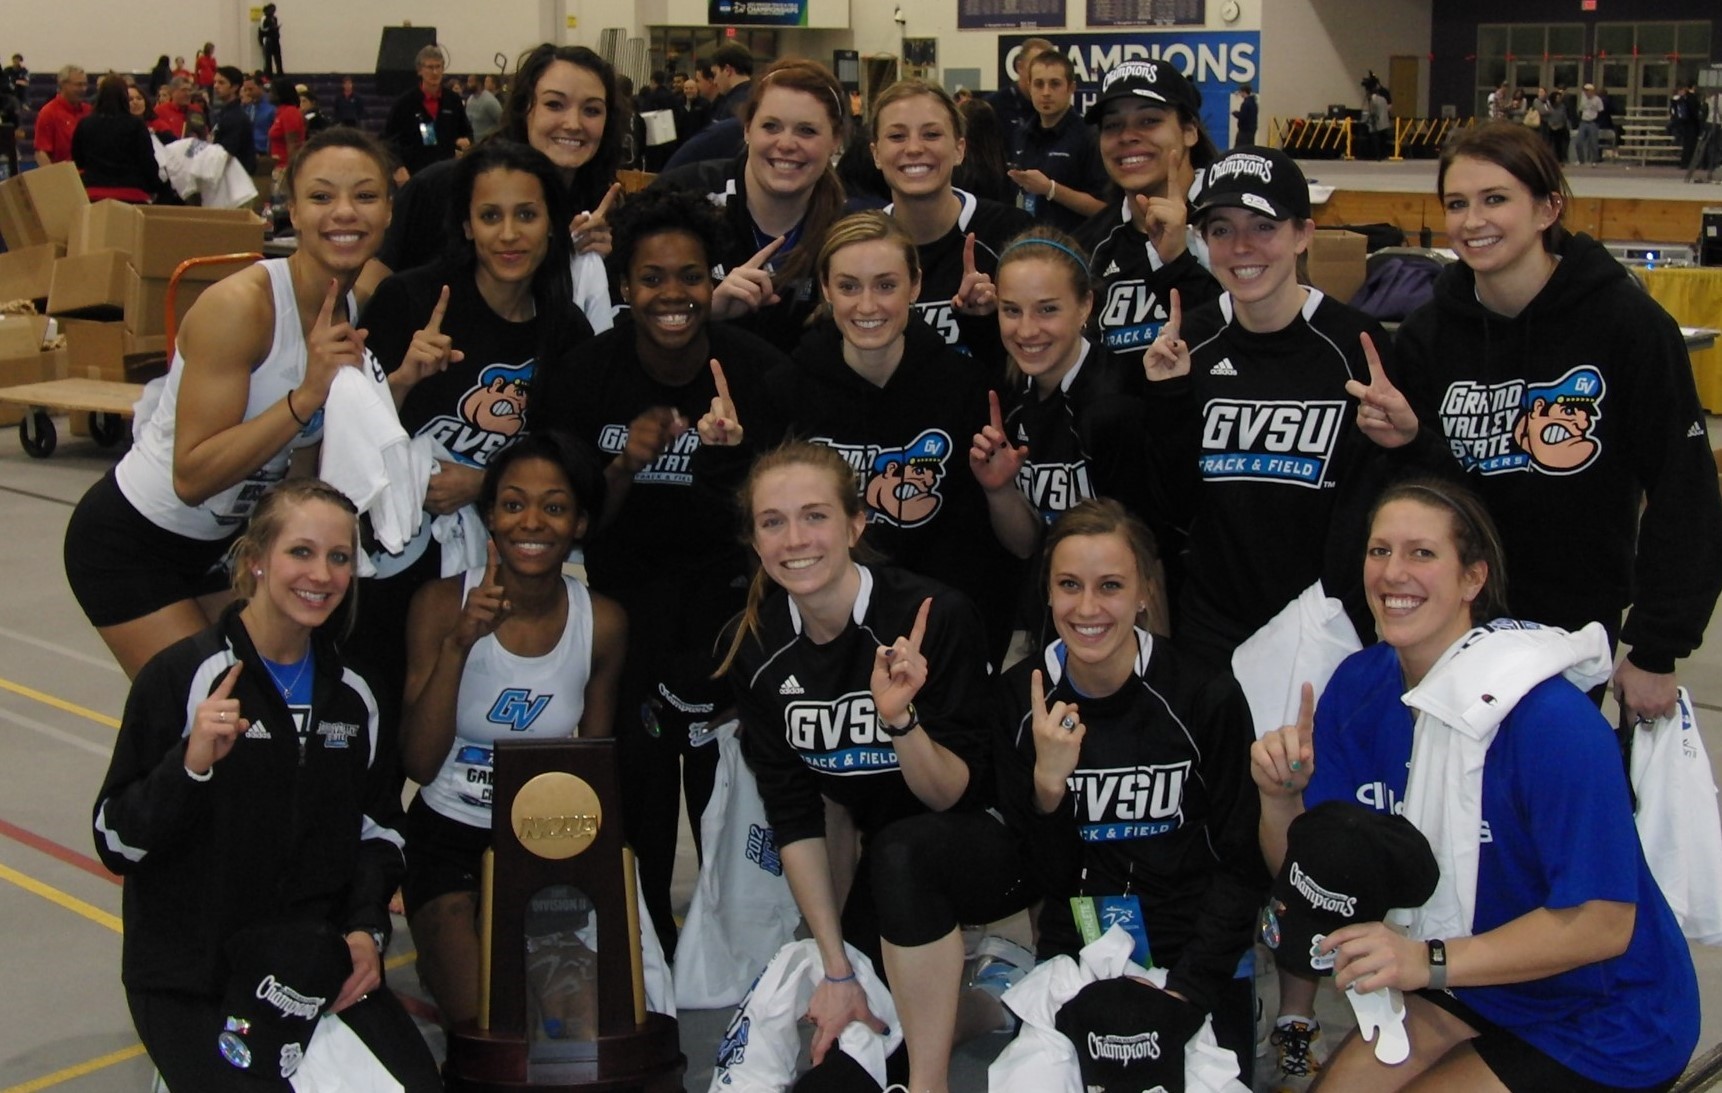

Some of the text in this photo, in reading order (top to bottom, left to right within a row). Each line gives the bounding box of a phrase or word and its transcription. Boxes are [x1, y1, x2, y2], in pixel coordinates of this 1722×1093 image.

[1208, 159, 1274, 188] Champions
[1445, 384, 1523, 415] GRAND
[1574, 377, 1596, 395] GV
[1202, 405, 1337, 453] GVSU
[1442, 408, 1520, 438] VALLEY
[924, 439, 942, 454] GV
[1450, 433, 1513, 460] STATE
[1251, 460, 1261, 471] &
[1267, 459, 1313, 476] FIELD
[486, 687, 556, 732] GV
[843, 753, 854, 767] &
[860, 751, 898, 765] FIELD
[1124, 823, 1170, 837] FIELD
[1289, 861, 1358, 918] Champions
[1087, 1031, 1161, 1067] Champions
